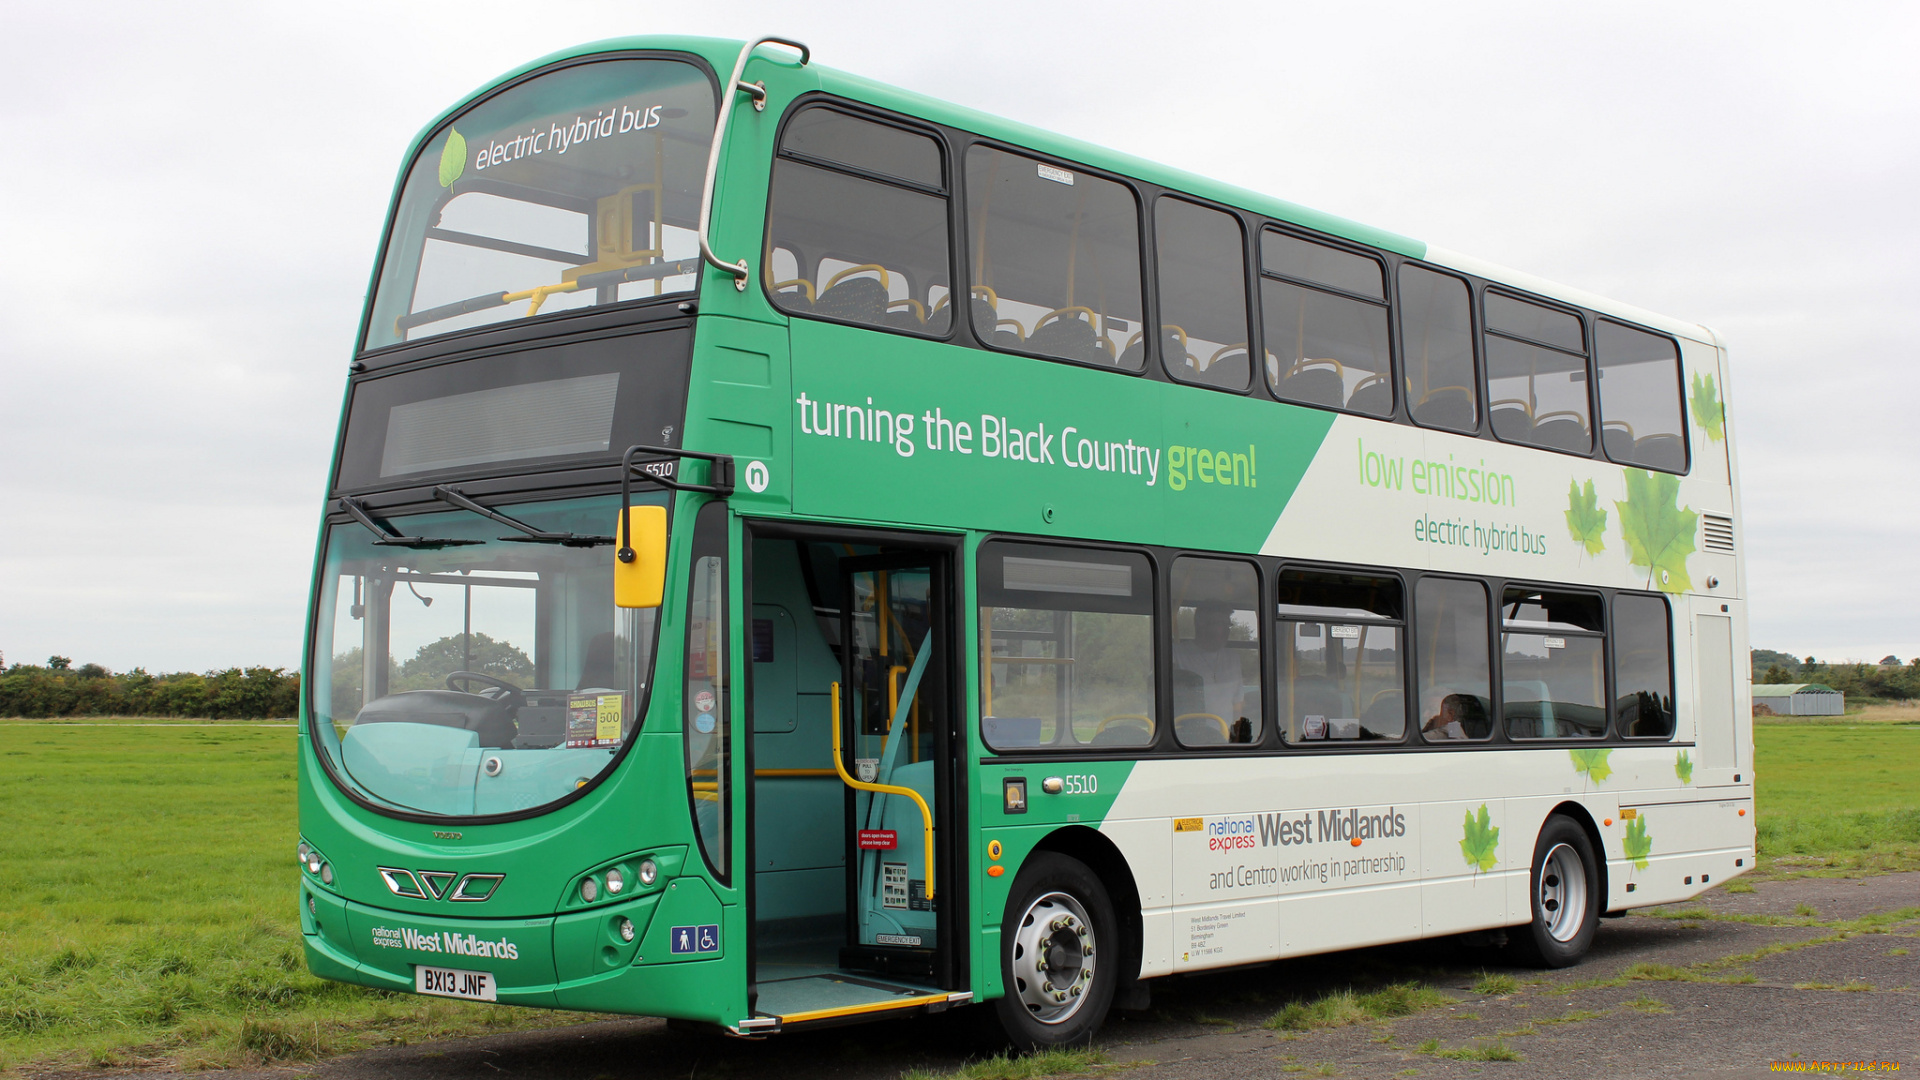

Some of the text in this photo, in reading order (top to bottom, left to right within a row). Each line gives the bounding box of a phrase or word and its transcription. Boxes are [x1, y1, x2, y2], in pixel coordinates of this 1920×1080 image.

[475, 105, 663, 171] electric hybrid bus
[796, 391, 1257, 492] turning the Black Country green!
[646, 462, 674, 477] 5510
[1357, 437, 1516, 507] low emission
[1414, 512, 1547, 556] electric hybrid bus
[599, 711, 620, 723] 500
[1066, 774, 1098, 794] 5510
[432, 831, 463, 840] VOLVO
[1208, 806, 1406, 847] national West Midlands
[1209, 834, 1256, 855] express
[1209, 851, 1406, 890] and Centro working in partnership
[1232, 911, 1246, 919] Limited
[371, 925, 519, 960] national West Midlands
[373, 937, 402, 948] express
[877, 935, 920, 945] EMERGENCY EXIT
[425, 969, 487, 996] BX13 JNF
